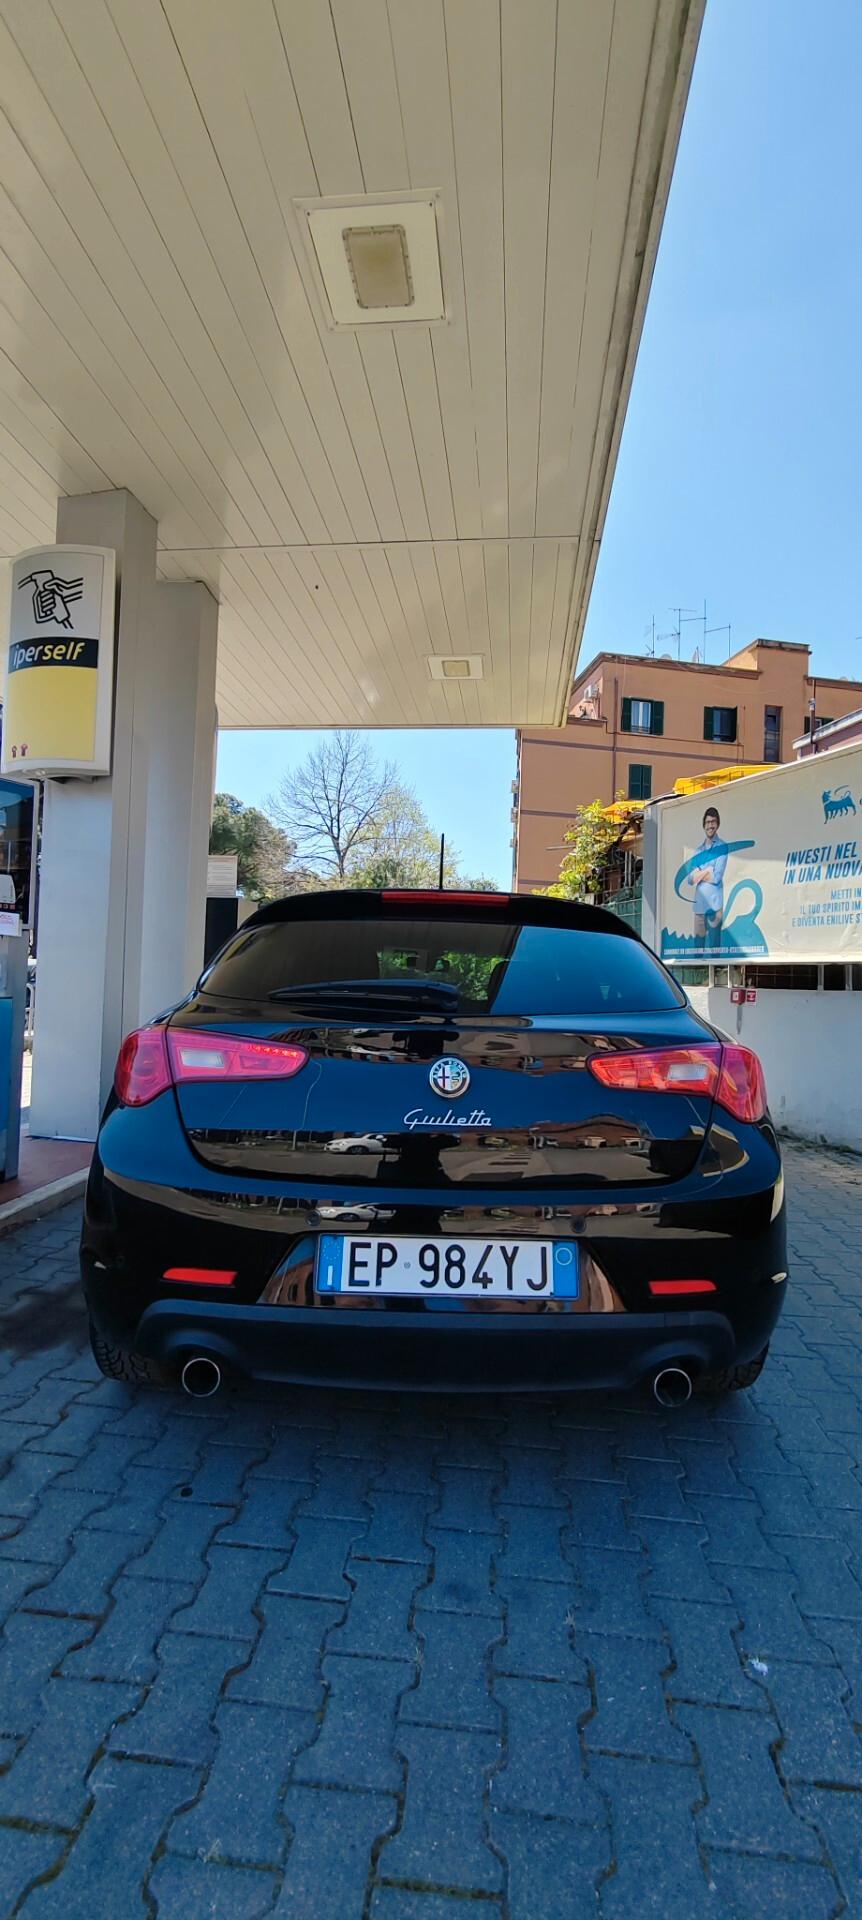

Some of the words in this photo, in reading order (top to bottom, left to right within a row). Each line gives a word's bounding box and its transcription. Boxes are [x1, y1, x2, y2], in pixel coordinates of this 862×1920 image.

[13, 641, 85, 669] iperself
[786, 845, 832, 867] INVESTI
[835, 841, 857, 860] NEL
[783, 869, 796, 885] IN
[798, 865, 822, 883] UNA
[831, 888, 852, 900] METTI
[800, 904, 806, 915] IL
[808, 904, 821, 914] TUO
[823, 901, 850, 913] SPIRITO
[797, 916, 825, 927] DIVENTA
[827, 913, 854, 926] ENILIVE
[403, 1108, 492, 1130] Giulietta
[348, 1242, 398, 1287] EP
[418, 1243, 548, 1291] 984YJ
